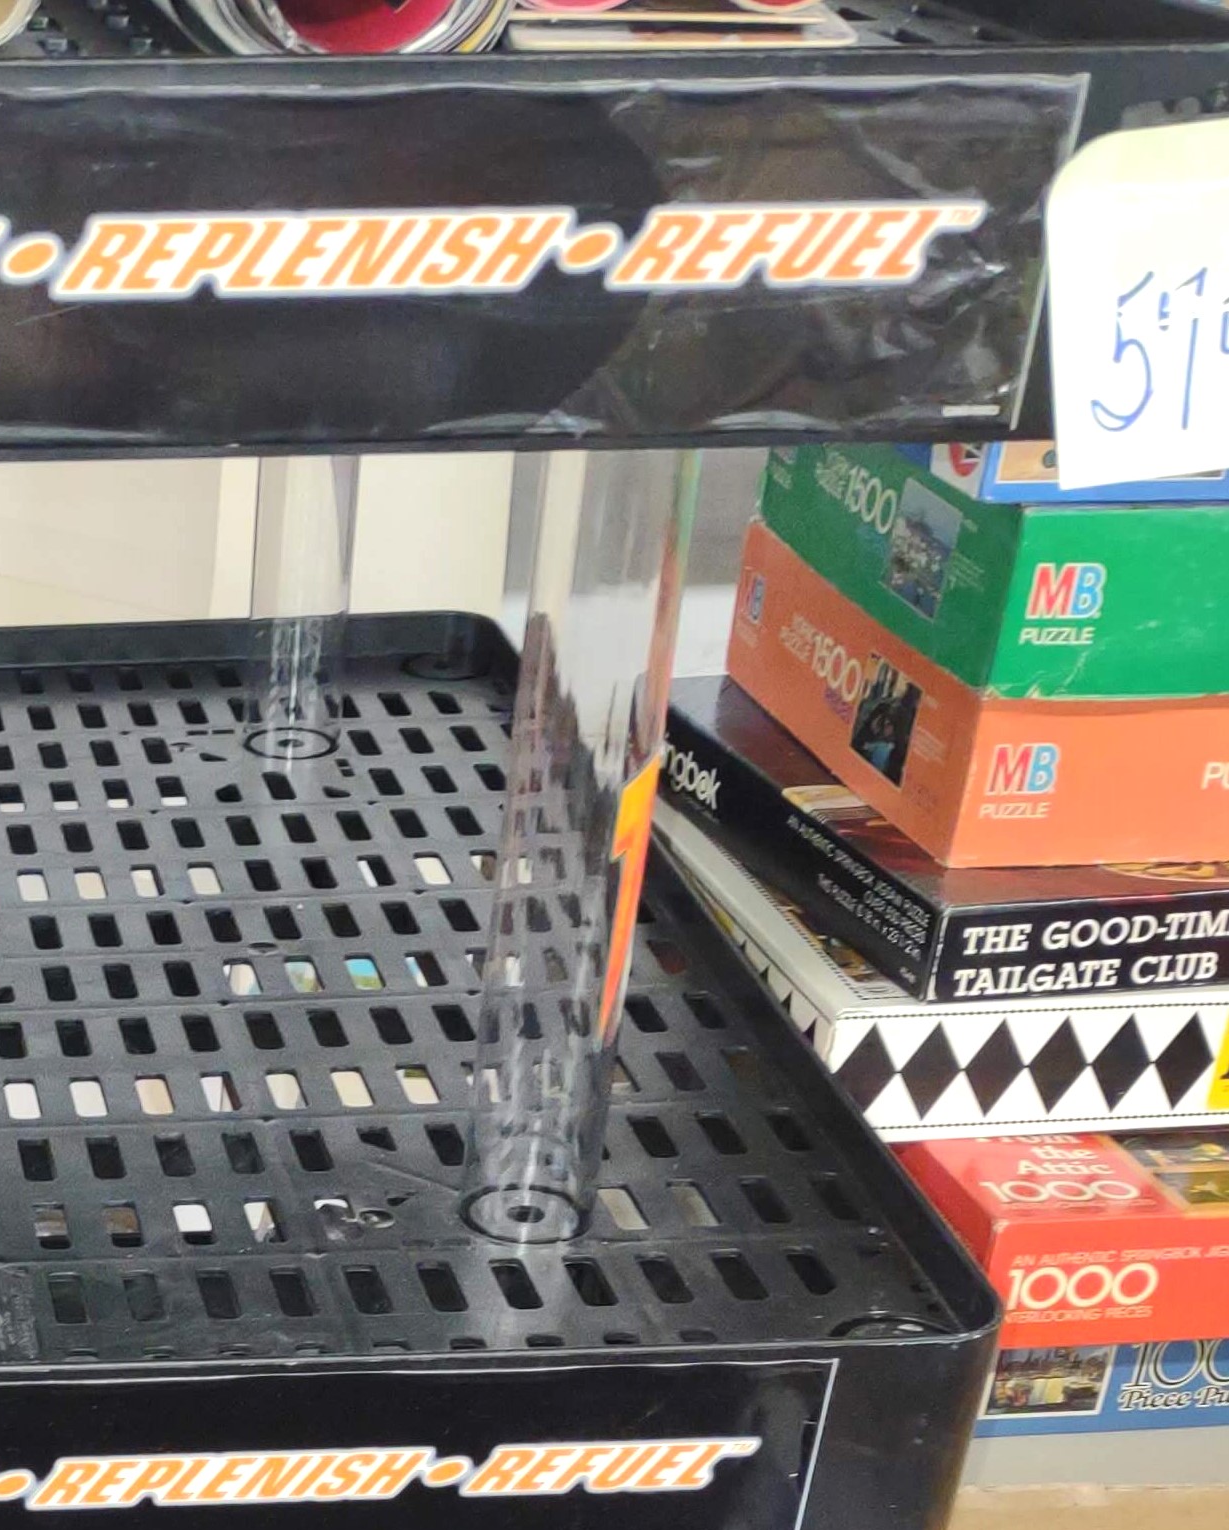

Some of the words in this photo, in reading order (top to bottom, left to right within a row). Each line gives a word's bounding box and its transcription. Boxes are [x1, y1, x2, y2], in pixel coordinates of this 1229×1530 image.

[54, 211, 573, 296] REPLENISH
[608, 205, 946, 288] REFUEL
[845, 463, 899, 535] 1500
[1026, 563, 1107, 620] MB
[1018, 626, 1096, 645] PUZZLE
[986, 742, 1061, 797] MB
[978, 801, 1053, 820] PUZZLE
[962, 923, 1033, 956] THE
[953, 958, 1122, 997] TAILGATE
[1129, 951, 1219, 985] CLUB
[1016, 1161, 1114, 1176] Attic
[1031, 1146, 1098, 1161] the
[979, 1180, 1140, 1203] 1000
[1006, 1261, 1160, 1312] 1000
[1003, 1309, 1102, 1323] NTERLOCKING
[1117, 1388, 1192, 1412] Piece
[30, 1449, 434, 1509] REPLENISH
[462, 1441, 735, 1495] REFUEL
